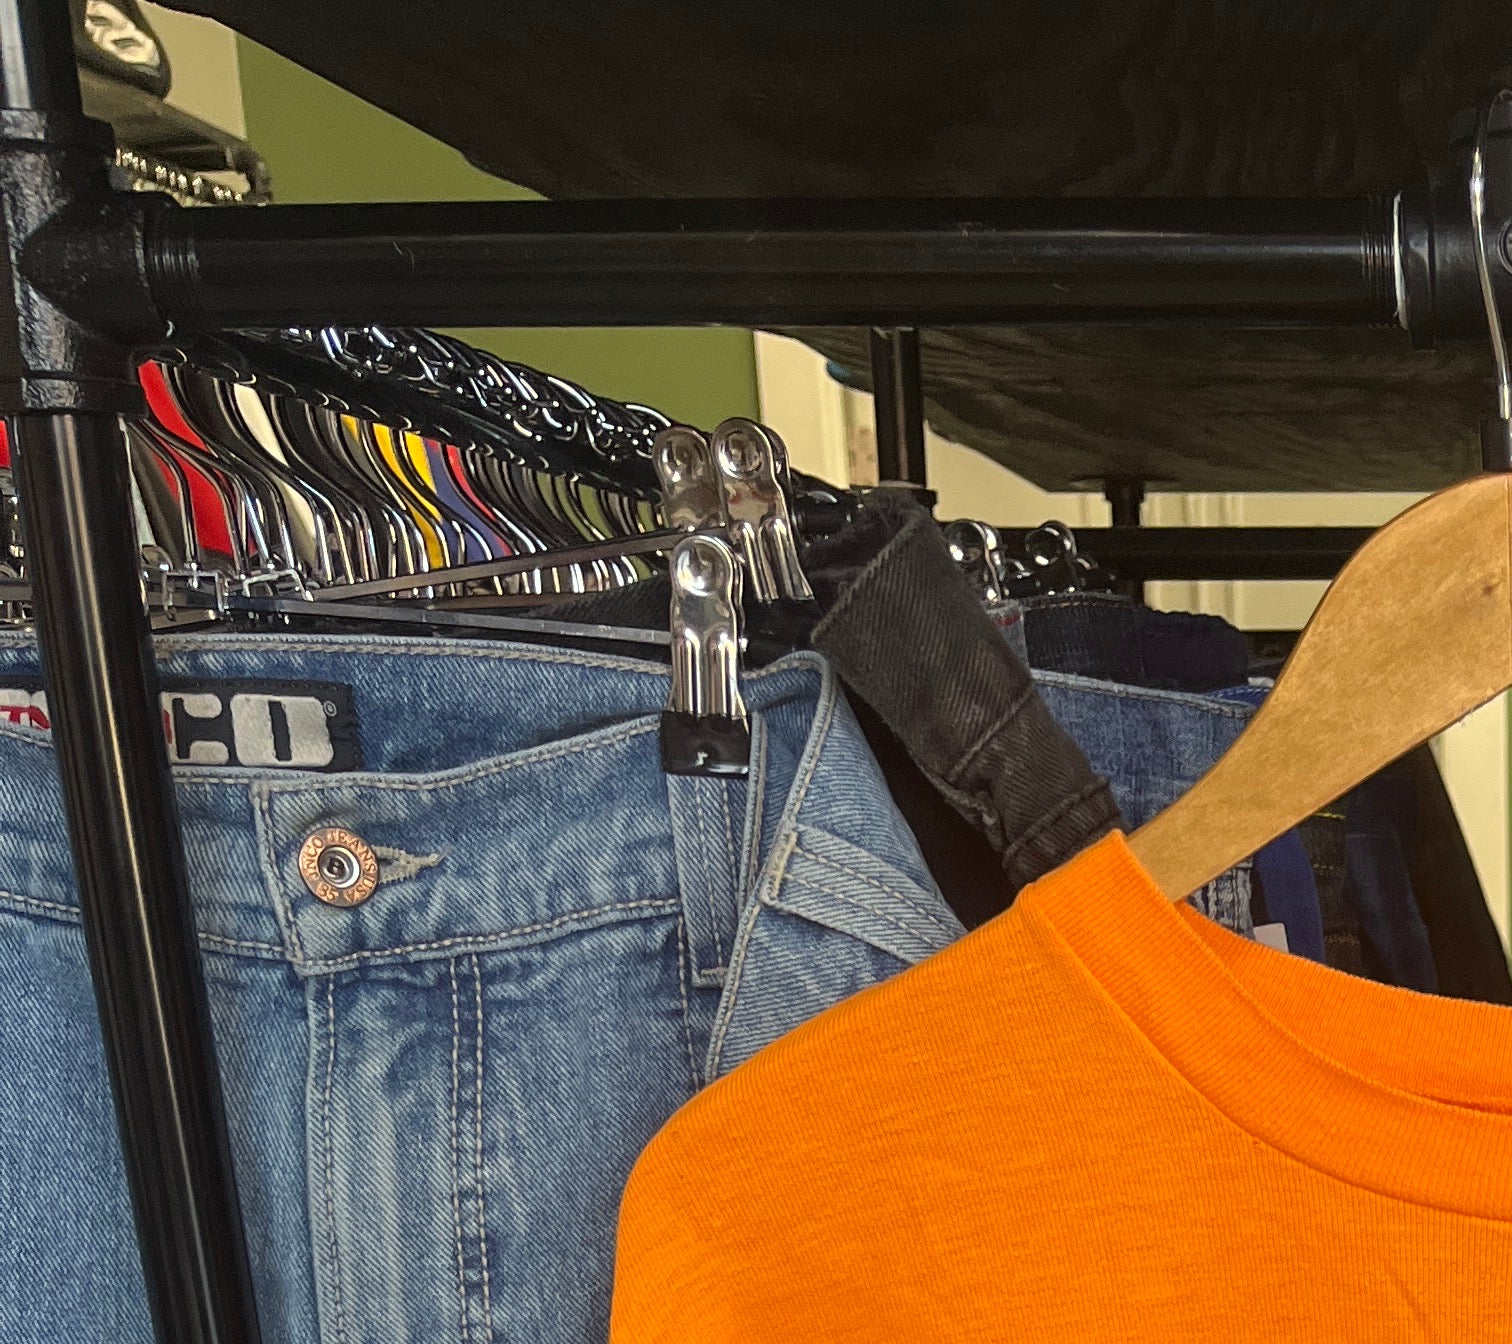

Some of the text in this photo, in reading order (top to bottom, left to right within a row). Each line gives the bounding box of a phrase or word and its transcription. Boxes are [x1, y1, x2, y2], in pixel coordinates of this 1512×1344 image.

[302, 829, 378, 902] JNCO JEANS USA
